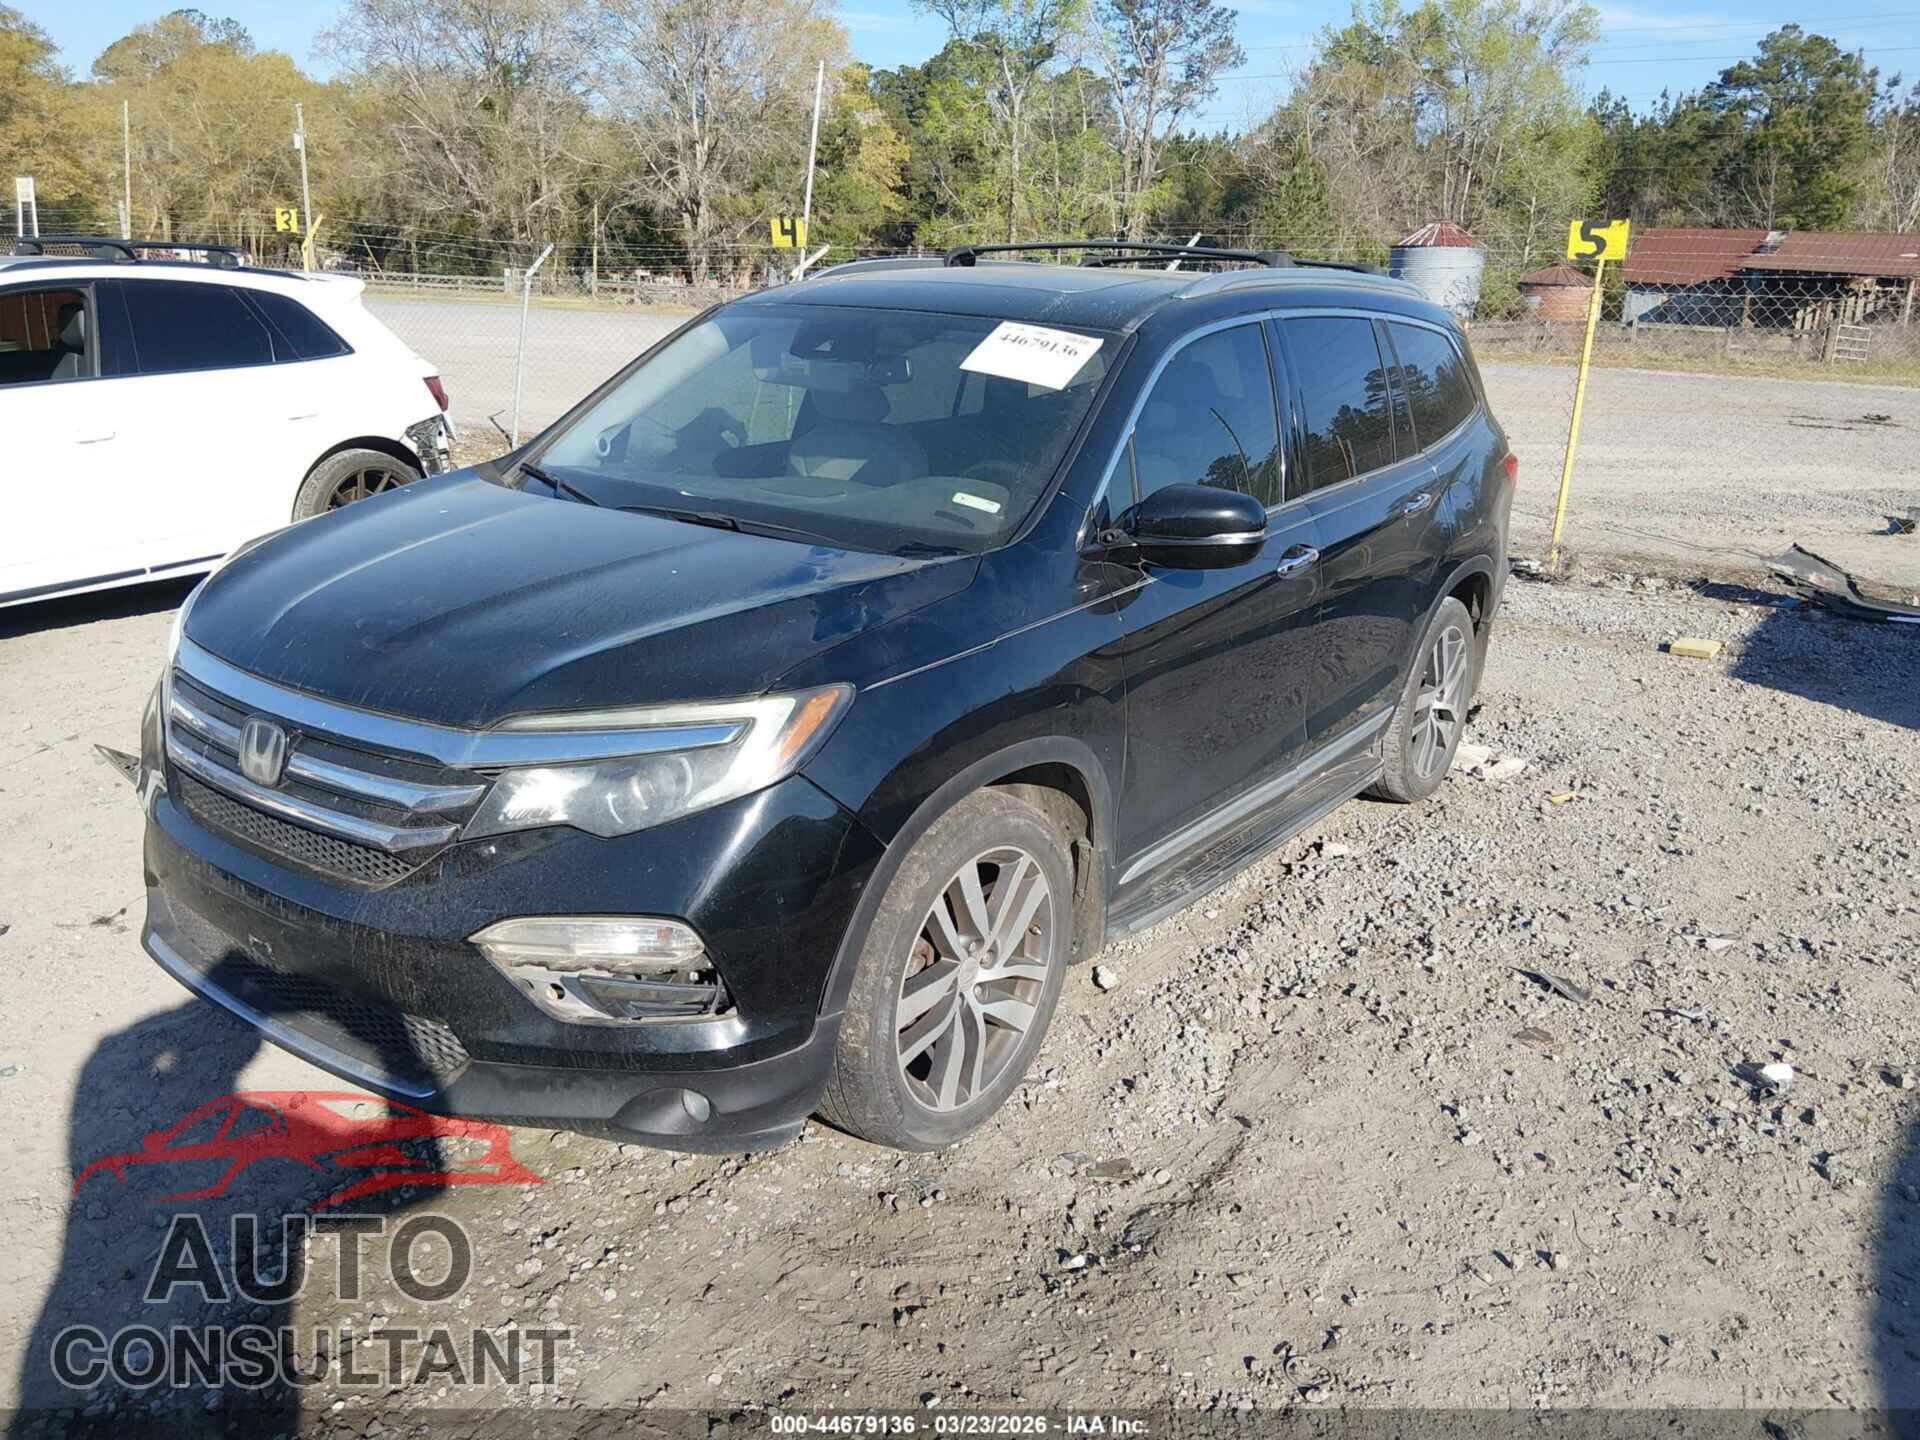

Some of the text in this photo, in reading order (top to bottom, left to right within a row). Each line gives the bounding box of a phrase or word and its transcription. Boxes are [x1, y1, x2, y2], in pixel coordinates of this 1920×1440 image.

[280, 210, 291, 231] 3
[779, 214, 797, 247] 4
[1575, 219, 1611, 259] 5
